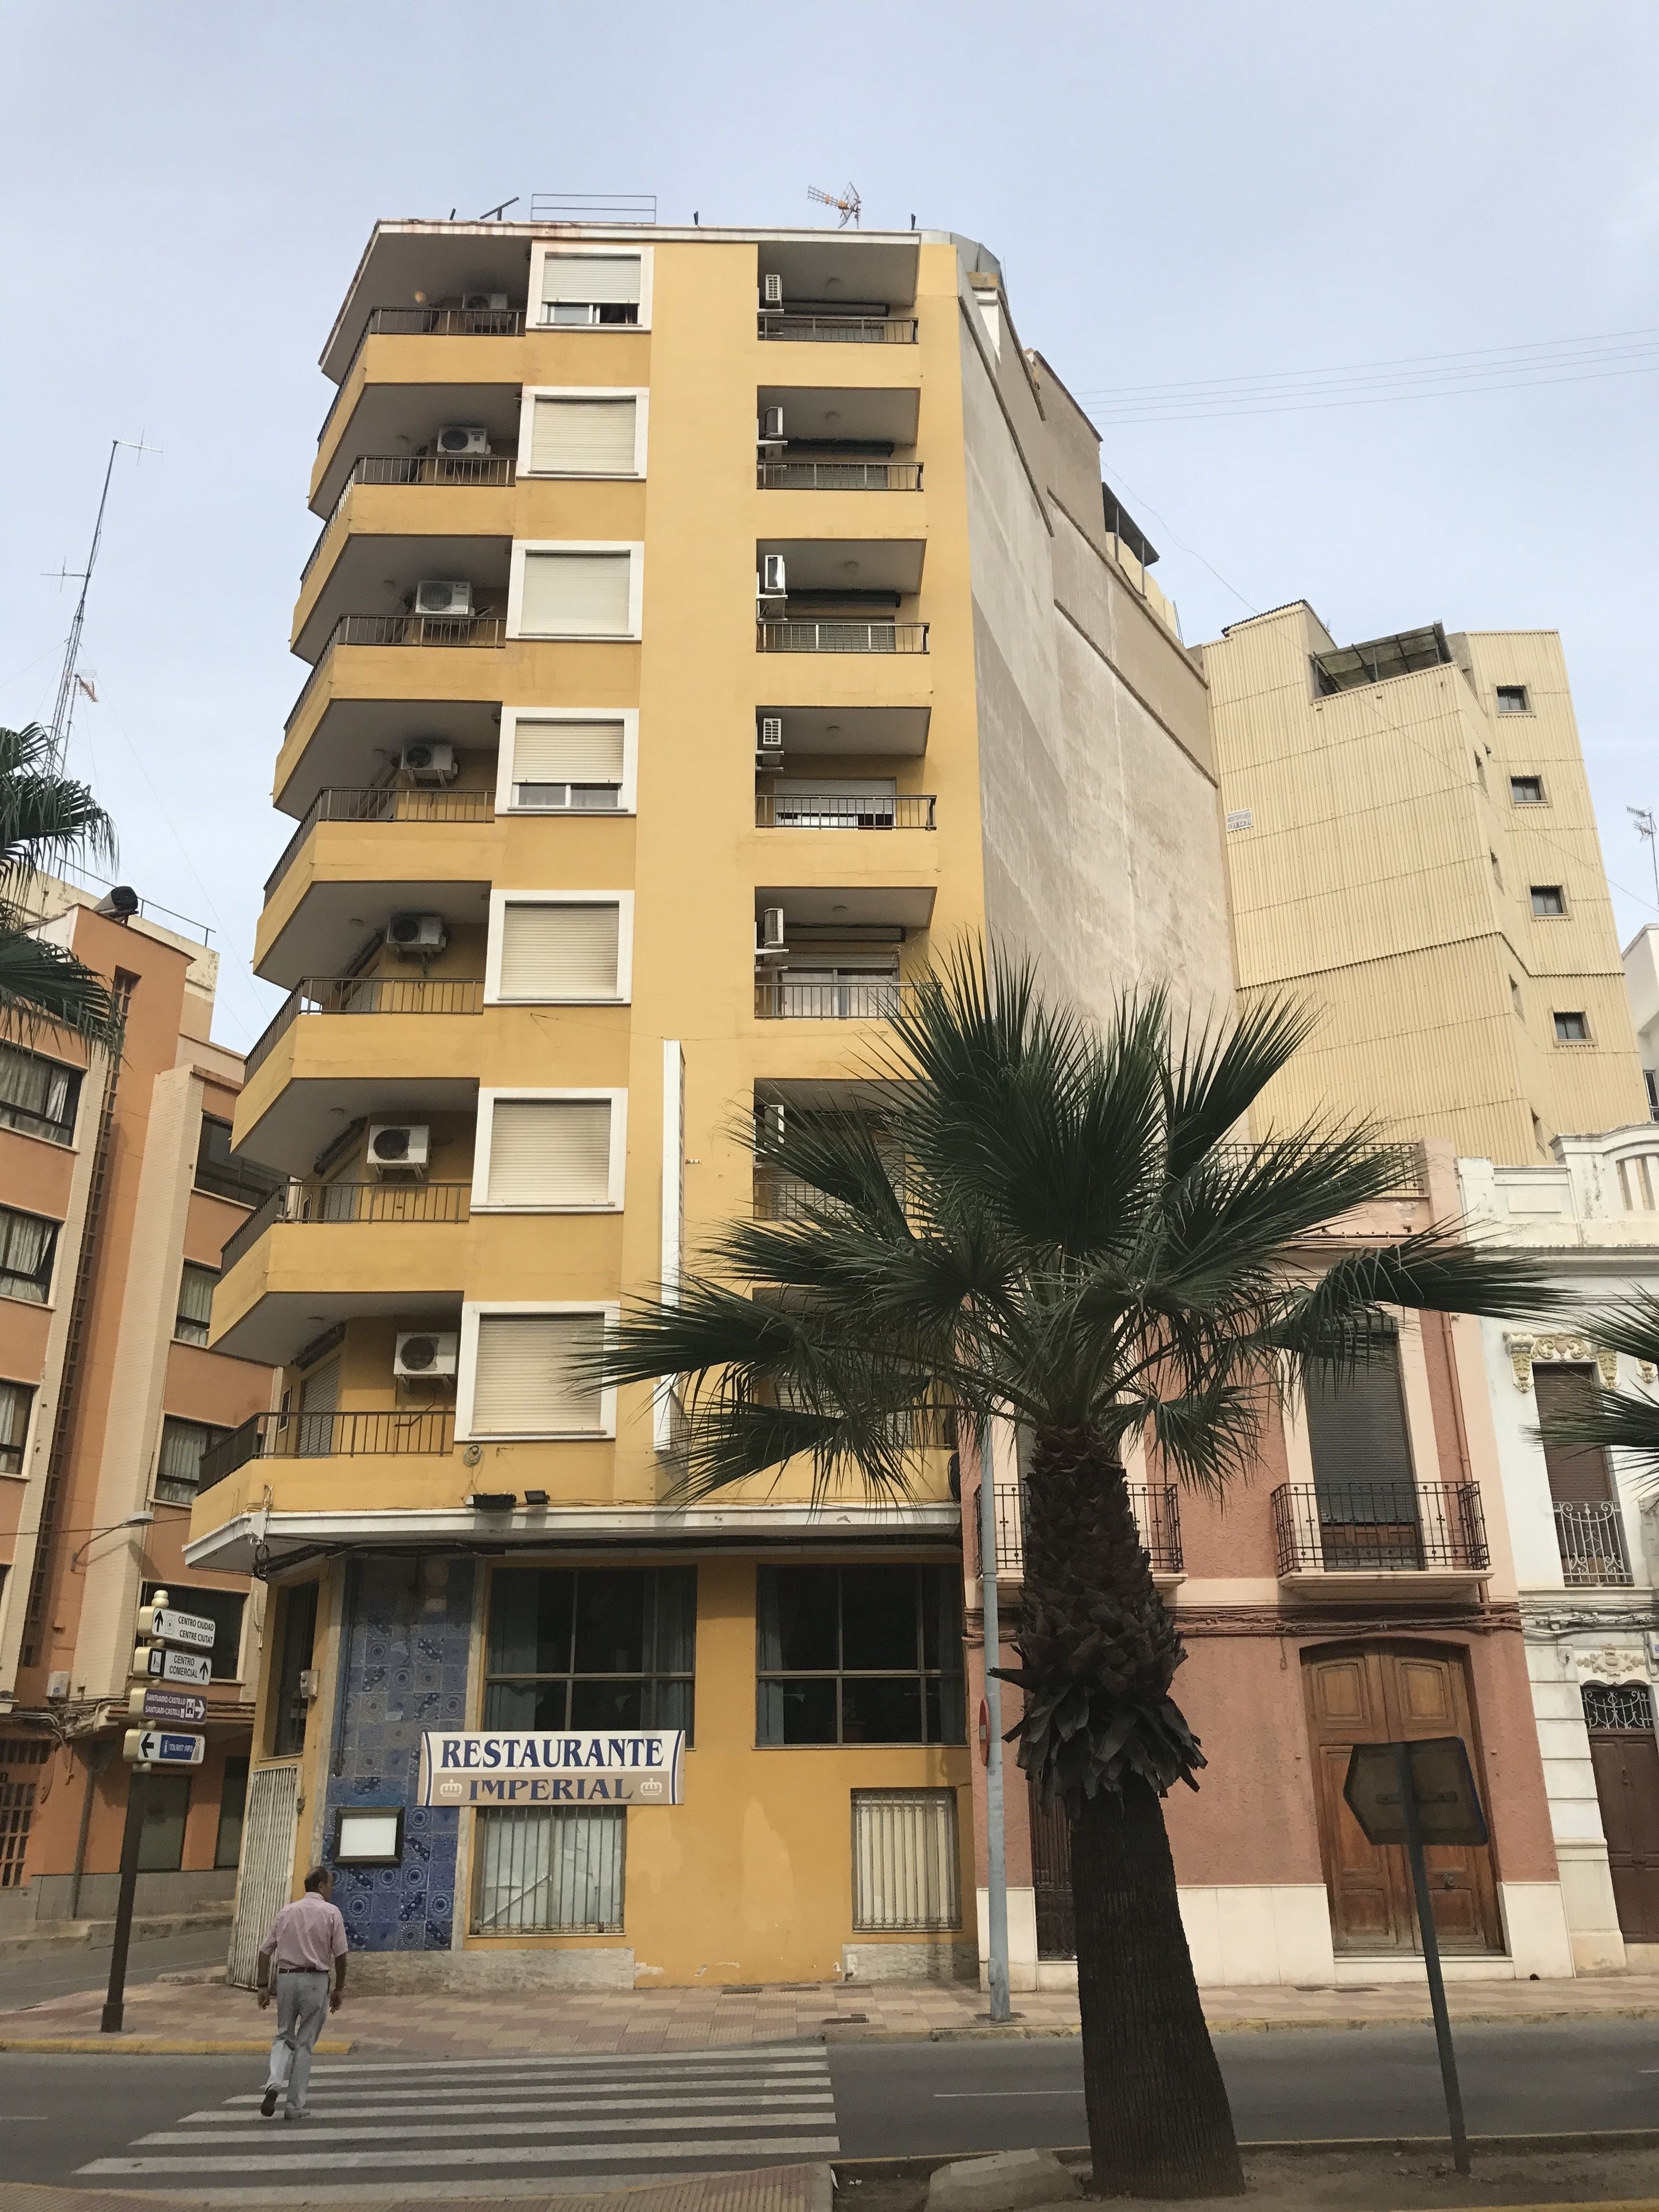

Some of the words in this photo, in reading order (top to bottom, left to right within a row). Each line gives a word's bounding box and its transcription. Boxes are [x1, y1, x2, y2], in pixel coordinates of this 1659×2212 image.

[178, 1616, 196, 1627] CENTRO
[197, 1620, 214, 1631] CIUDAD
[179, 1630, 197, 1641] CENTRE
[198, 1634, 213, 1643] CIUTAT
[174, 1655, 195, 1666] CENTRO
[169, 1665, 198, 1678] COMERCIAL
[169, 1743, 184, 1751] TOURIST
[184, 1744, 193, 1752] INFO
[440, 1738, 664, 1768] RESTAURANTE
[469, 1778, 634, 1801] IMPERIAL
